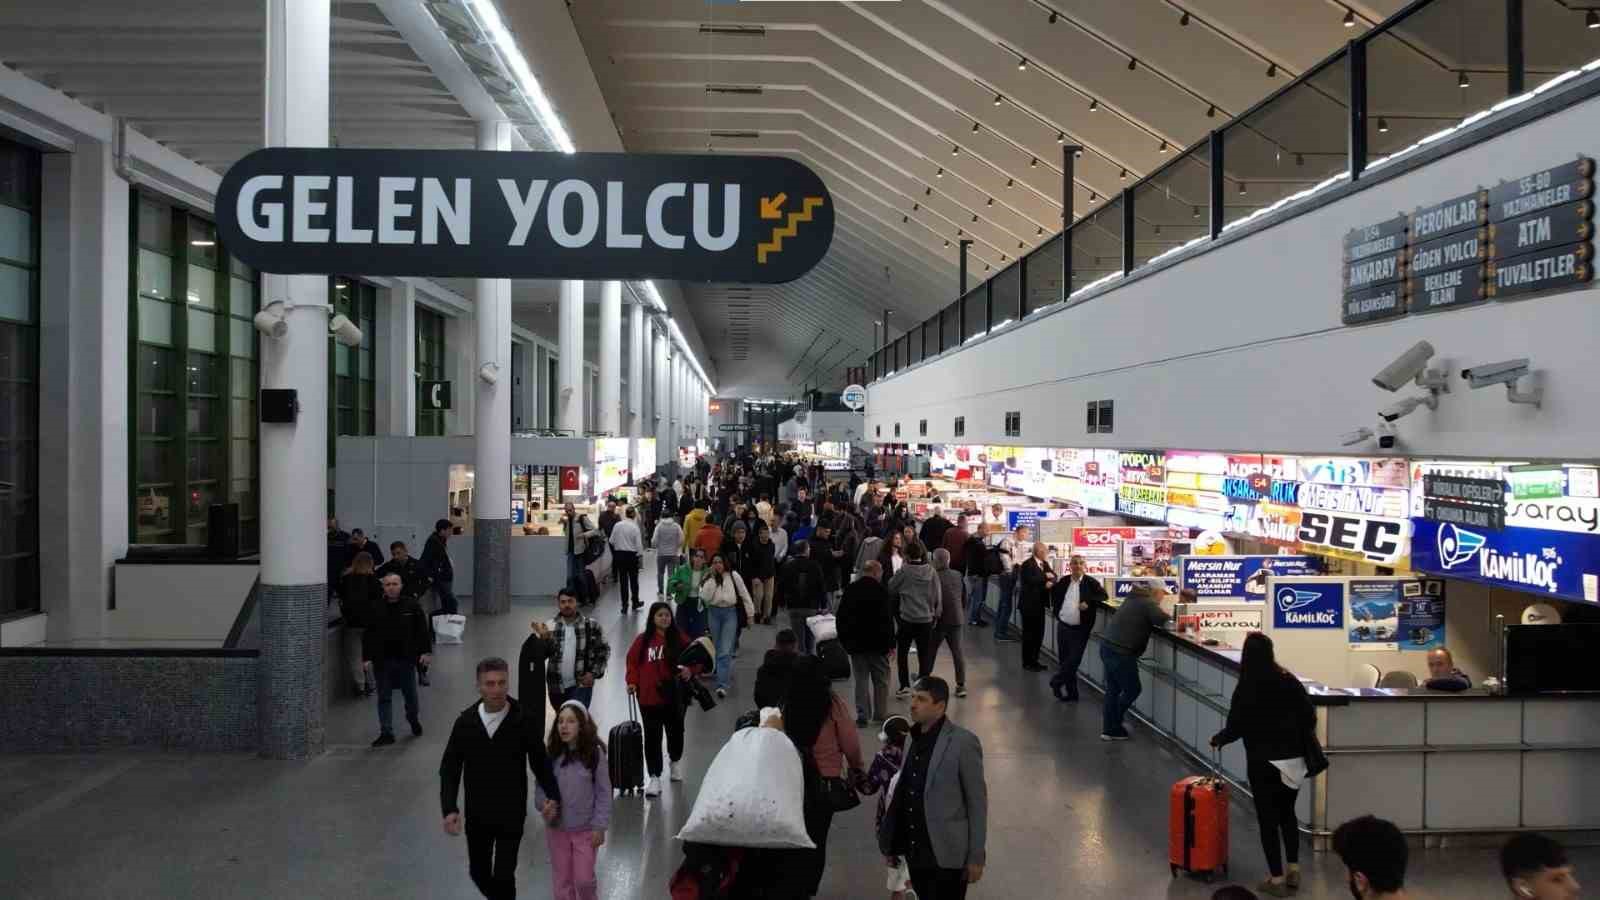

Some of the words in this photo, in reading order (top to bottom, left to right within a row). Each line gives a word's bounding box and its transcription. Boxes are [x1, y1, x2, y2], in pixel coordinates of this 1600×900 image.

[236, 175, 471, 246] GELEN
[498, 179, 741, 252] YOLCU
[1415, 199, 1477, 238] PERONLAR
[1517, 216, 1551, 248] ATM
[1412, 247, 1442, 272] GİDEN
[1444, 239, 1478, 264] YOLCU
[1497, 254, 1576, 288] TUVALETLER
[1350, 257, 1397, 286] ANKARAY
[1424, 269, 1463, 292] BEKLEME
[1430, 287, 1456, 306] ALANI
[1254, 478, 1267, 488] 54
[1504, 500, 1598, 531] saray
[1300, 512, 1400, 561] SEÇ
[1187, 561, 1222, 571] Mersin
[1223, 561, 1242, 571] Nur
